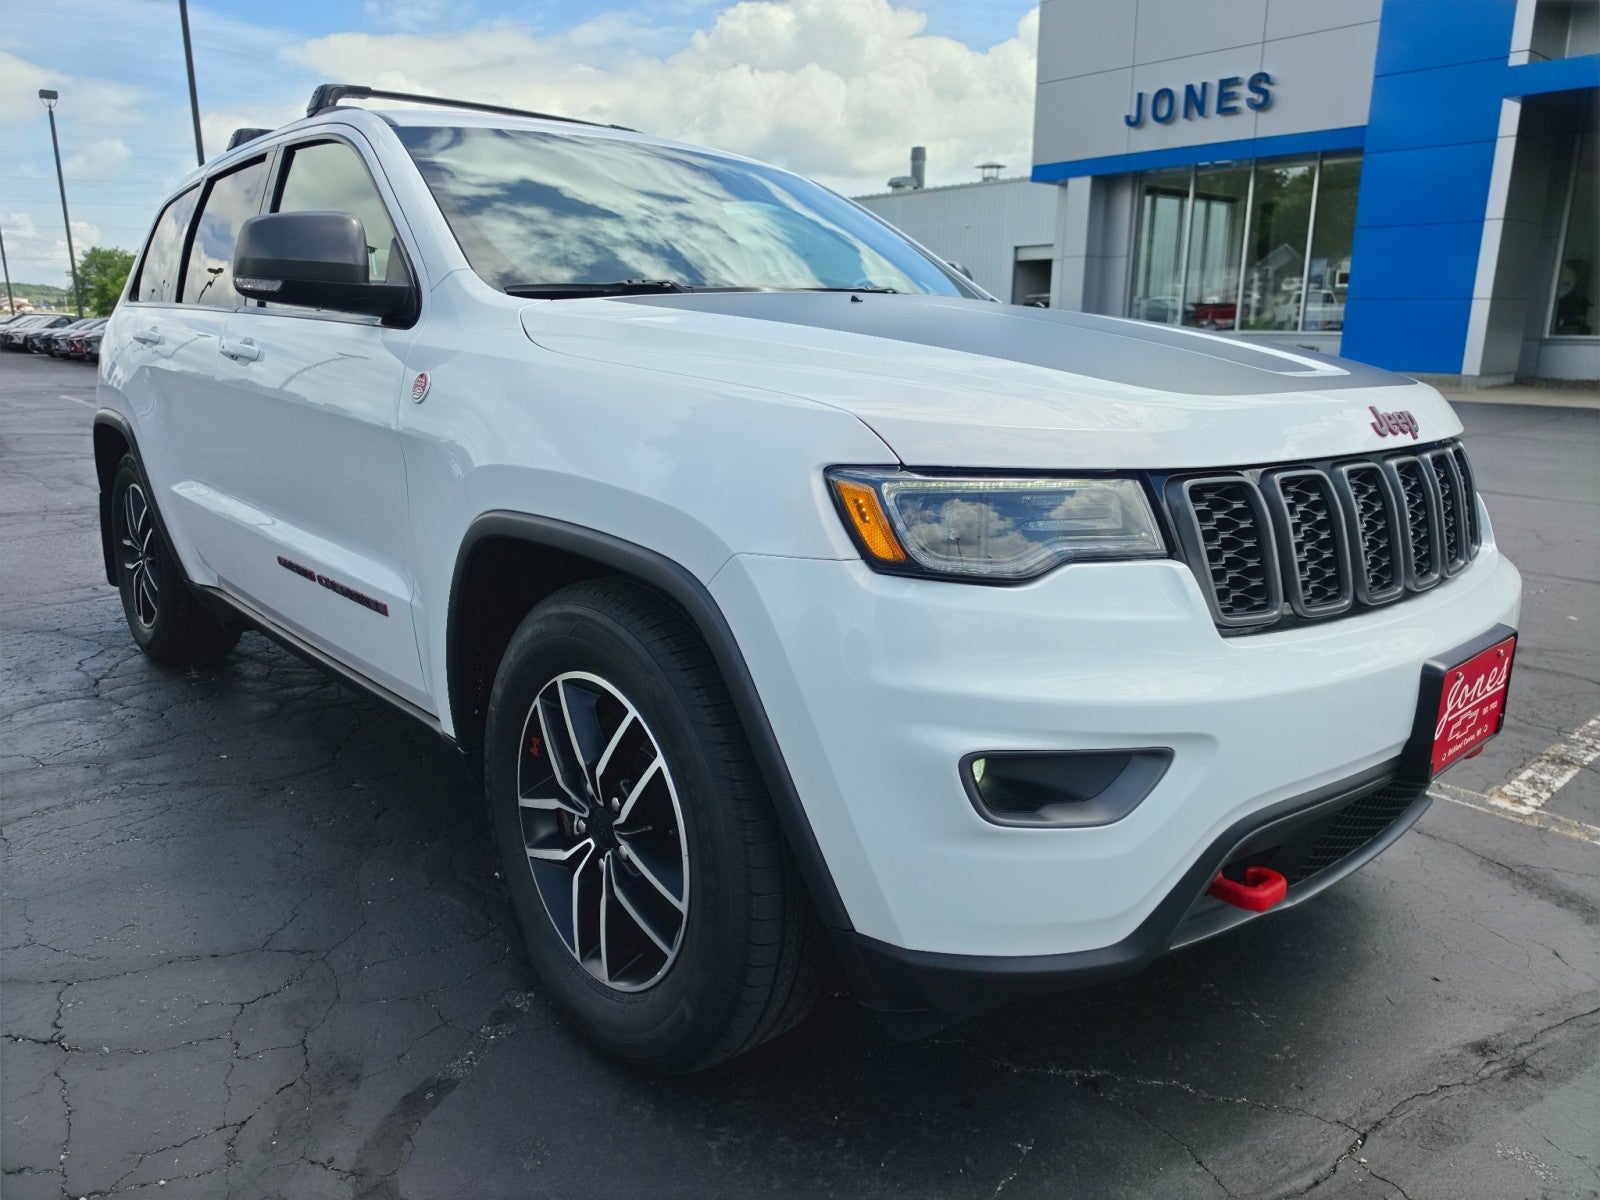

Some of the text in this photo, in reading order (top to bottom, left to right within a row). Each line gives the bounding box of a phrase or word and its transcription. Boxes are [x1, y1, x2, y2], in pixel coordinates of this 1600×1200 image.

[1124, 71, 1273, 128] JONES
[1368, 405, 1420, 440] Jeep
[1433, 656, 1509, 741] Jones
